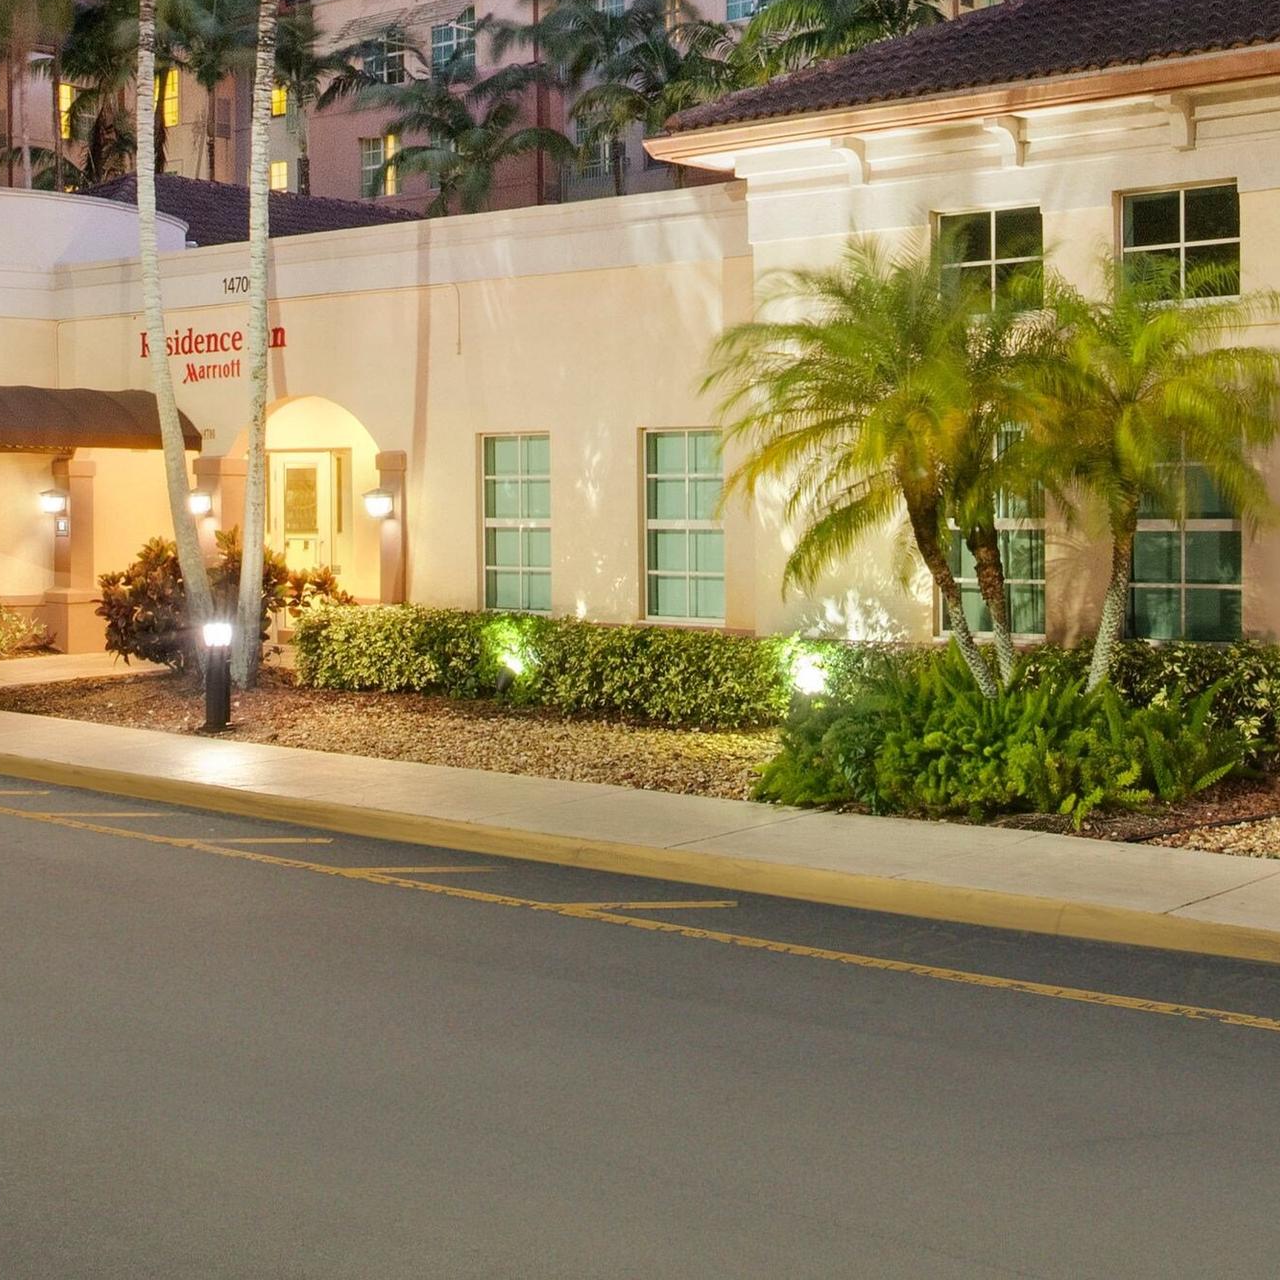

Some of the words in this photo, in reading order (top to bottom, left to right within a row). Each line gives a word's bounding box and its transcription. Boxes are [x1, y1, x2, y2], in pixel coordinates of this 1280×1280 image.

[223, 276, 251, 294] 1470
[140, 328, 242, 358] Rsidence
[182, 359, 240, 384] Marriott
